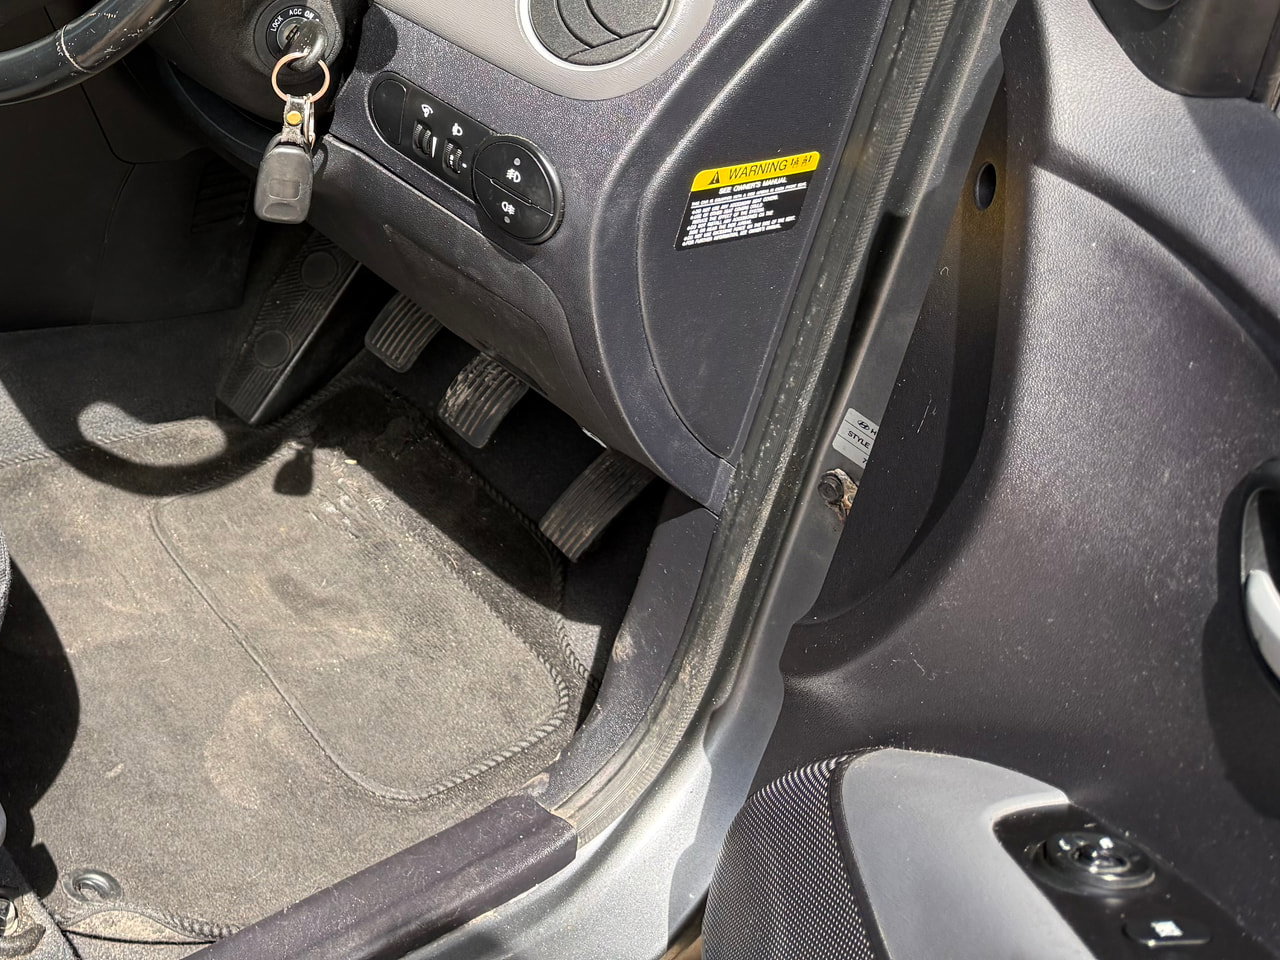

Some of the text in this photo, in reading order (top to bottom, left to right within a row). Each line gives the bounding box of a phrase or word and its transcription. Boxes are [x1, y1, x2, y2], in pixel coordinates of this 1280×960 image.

[270, 8, 315, 32] LOCK ACC ON
[729, 159, 788, 180] WARNING
[847, 430, 871, 449] STYLE
